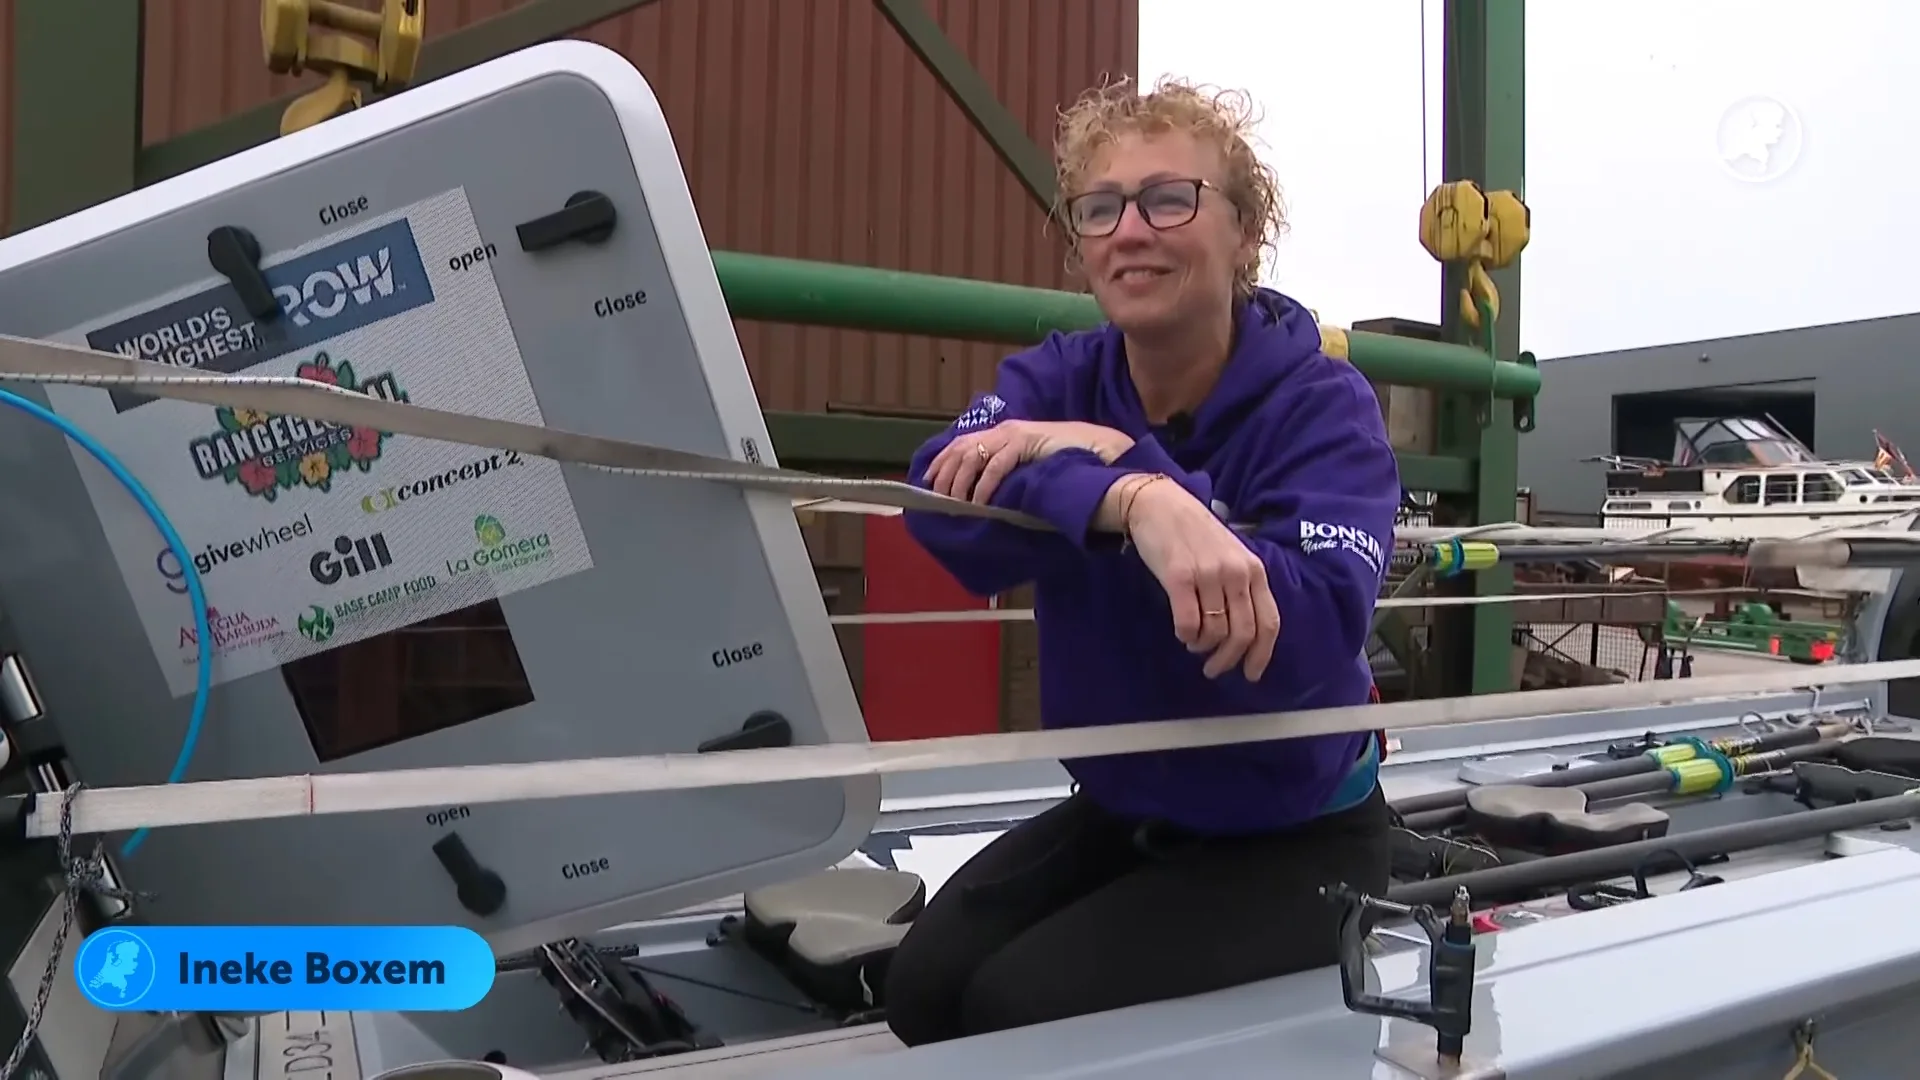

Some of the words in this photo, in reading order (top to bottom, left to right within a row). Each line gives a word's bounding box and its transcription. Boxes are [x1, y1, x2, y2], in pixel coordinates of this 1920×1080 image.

[318, 194, 369, 226] Close
[449, 243, 497, 271] open
[593, 289, 649, 319] Close
[114, 306, 233, 359] WORLD'S
[158, 321, 257, 369] UGHEST
[262, 428, 352, 467] SERVICES
[194, 512, 313, 575] givewheel
[309, 532, 393, 585] Gill
[473, 533, 551, 567] Gomera
[334, 598, 367, 618] BASE
[368, 585, 401, 607] CAMP
[403, 575, 437, 597] FOOD
[712, 641, 764, 669] Close
[426, 804, 471, 827] open
[561, 857, 610, 881] Close
